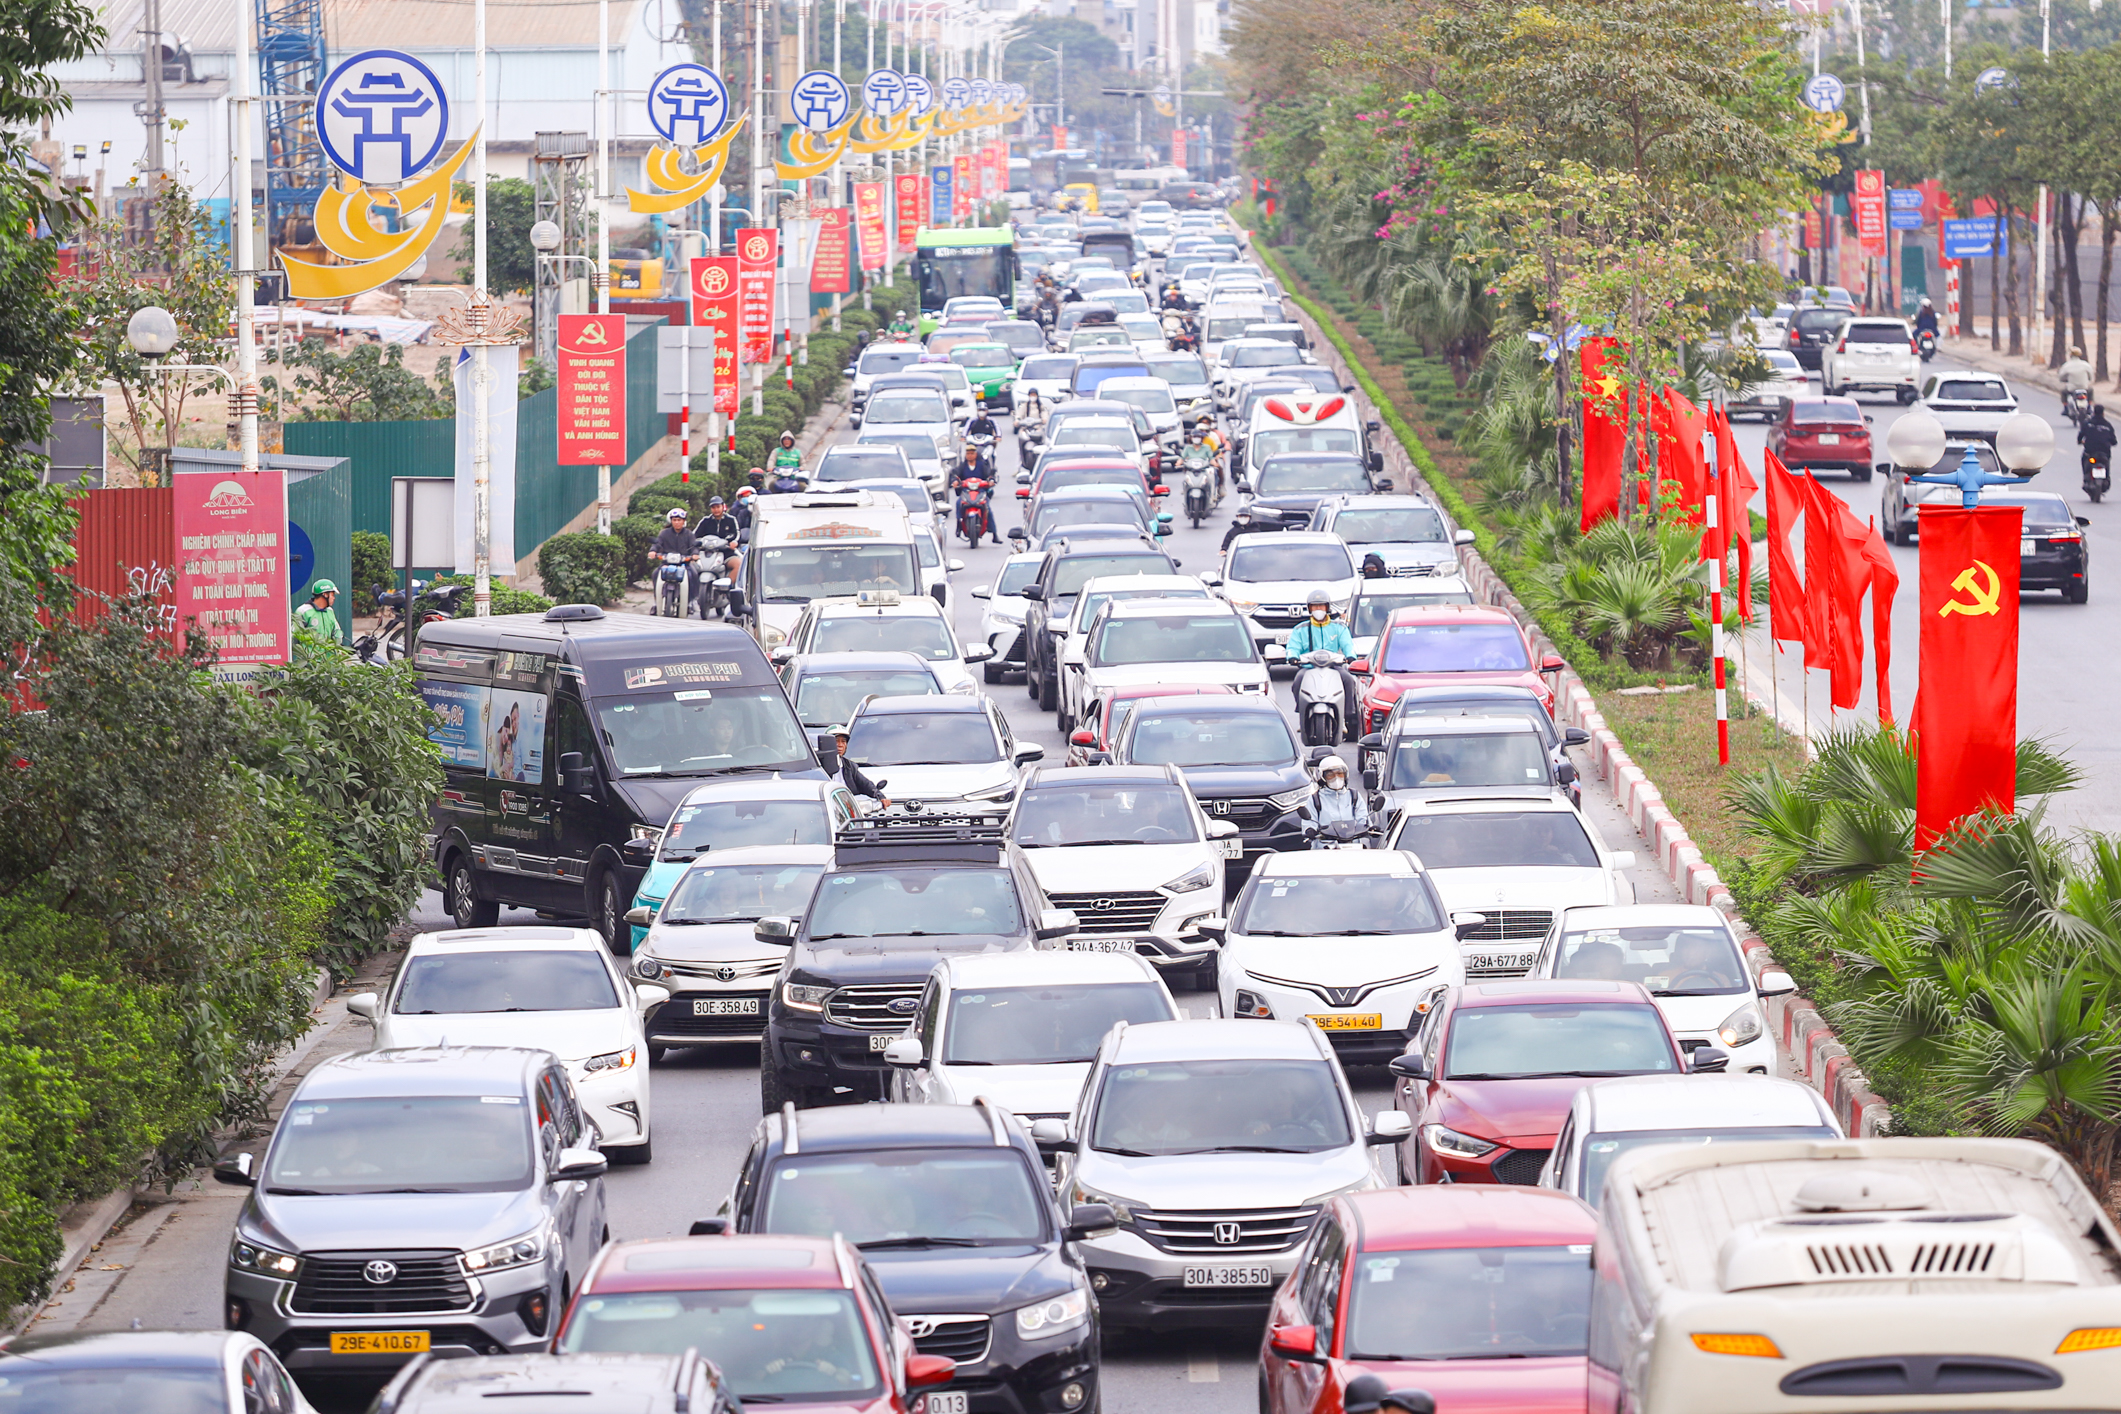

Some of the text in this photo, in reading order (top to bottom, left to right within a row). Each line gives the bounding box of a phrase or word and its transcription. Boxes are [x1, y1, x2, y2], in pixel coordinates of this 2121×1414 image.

[621, 280, 640, 288] 200
[589, 359, 615, 367] QUANG
[574, 382, 598, 392] THUỘC
[594, 394, 608, 404] TỘC
[573, 407, 590, 417] VIỆT
[564, 430, 575, 439] VÀ
[182, 529, 277, 550] NGHIÊM CHỈNH CHẤP HÀNH
[202, 560, 216, 575] QUY
[218, 560, 235, 577] ĐỊNH
[237, 555, 246, 573] VỀ
[247, 556, 264, 575] TRẬT
[266, 557, 276, 574] TỰ
[193, 581, 270, 600] AN TOÀN GIAO THÔNG,
[247, 609, 258, 626] THỊ
[246, 630, 276, 648] TRƯỜNG!
[665, 663, 711, 676] HOÀNG
[1075, 941, 1133, 953] 34A-36242
[1473, 954, 1533, 968] 29A-677.88
[695, 1001, 756, 1013] 30E-358.49
[896, 1001, 915, 1009] Ford
[1187, 1268, 1269, 1284] 30A-385.50
[340, 1336, 421, 1349] 29E-410.67
